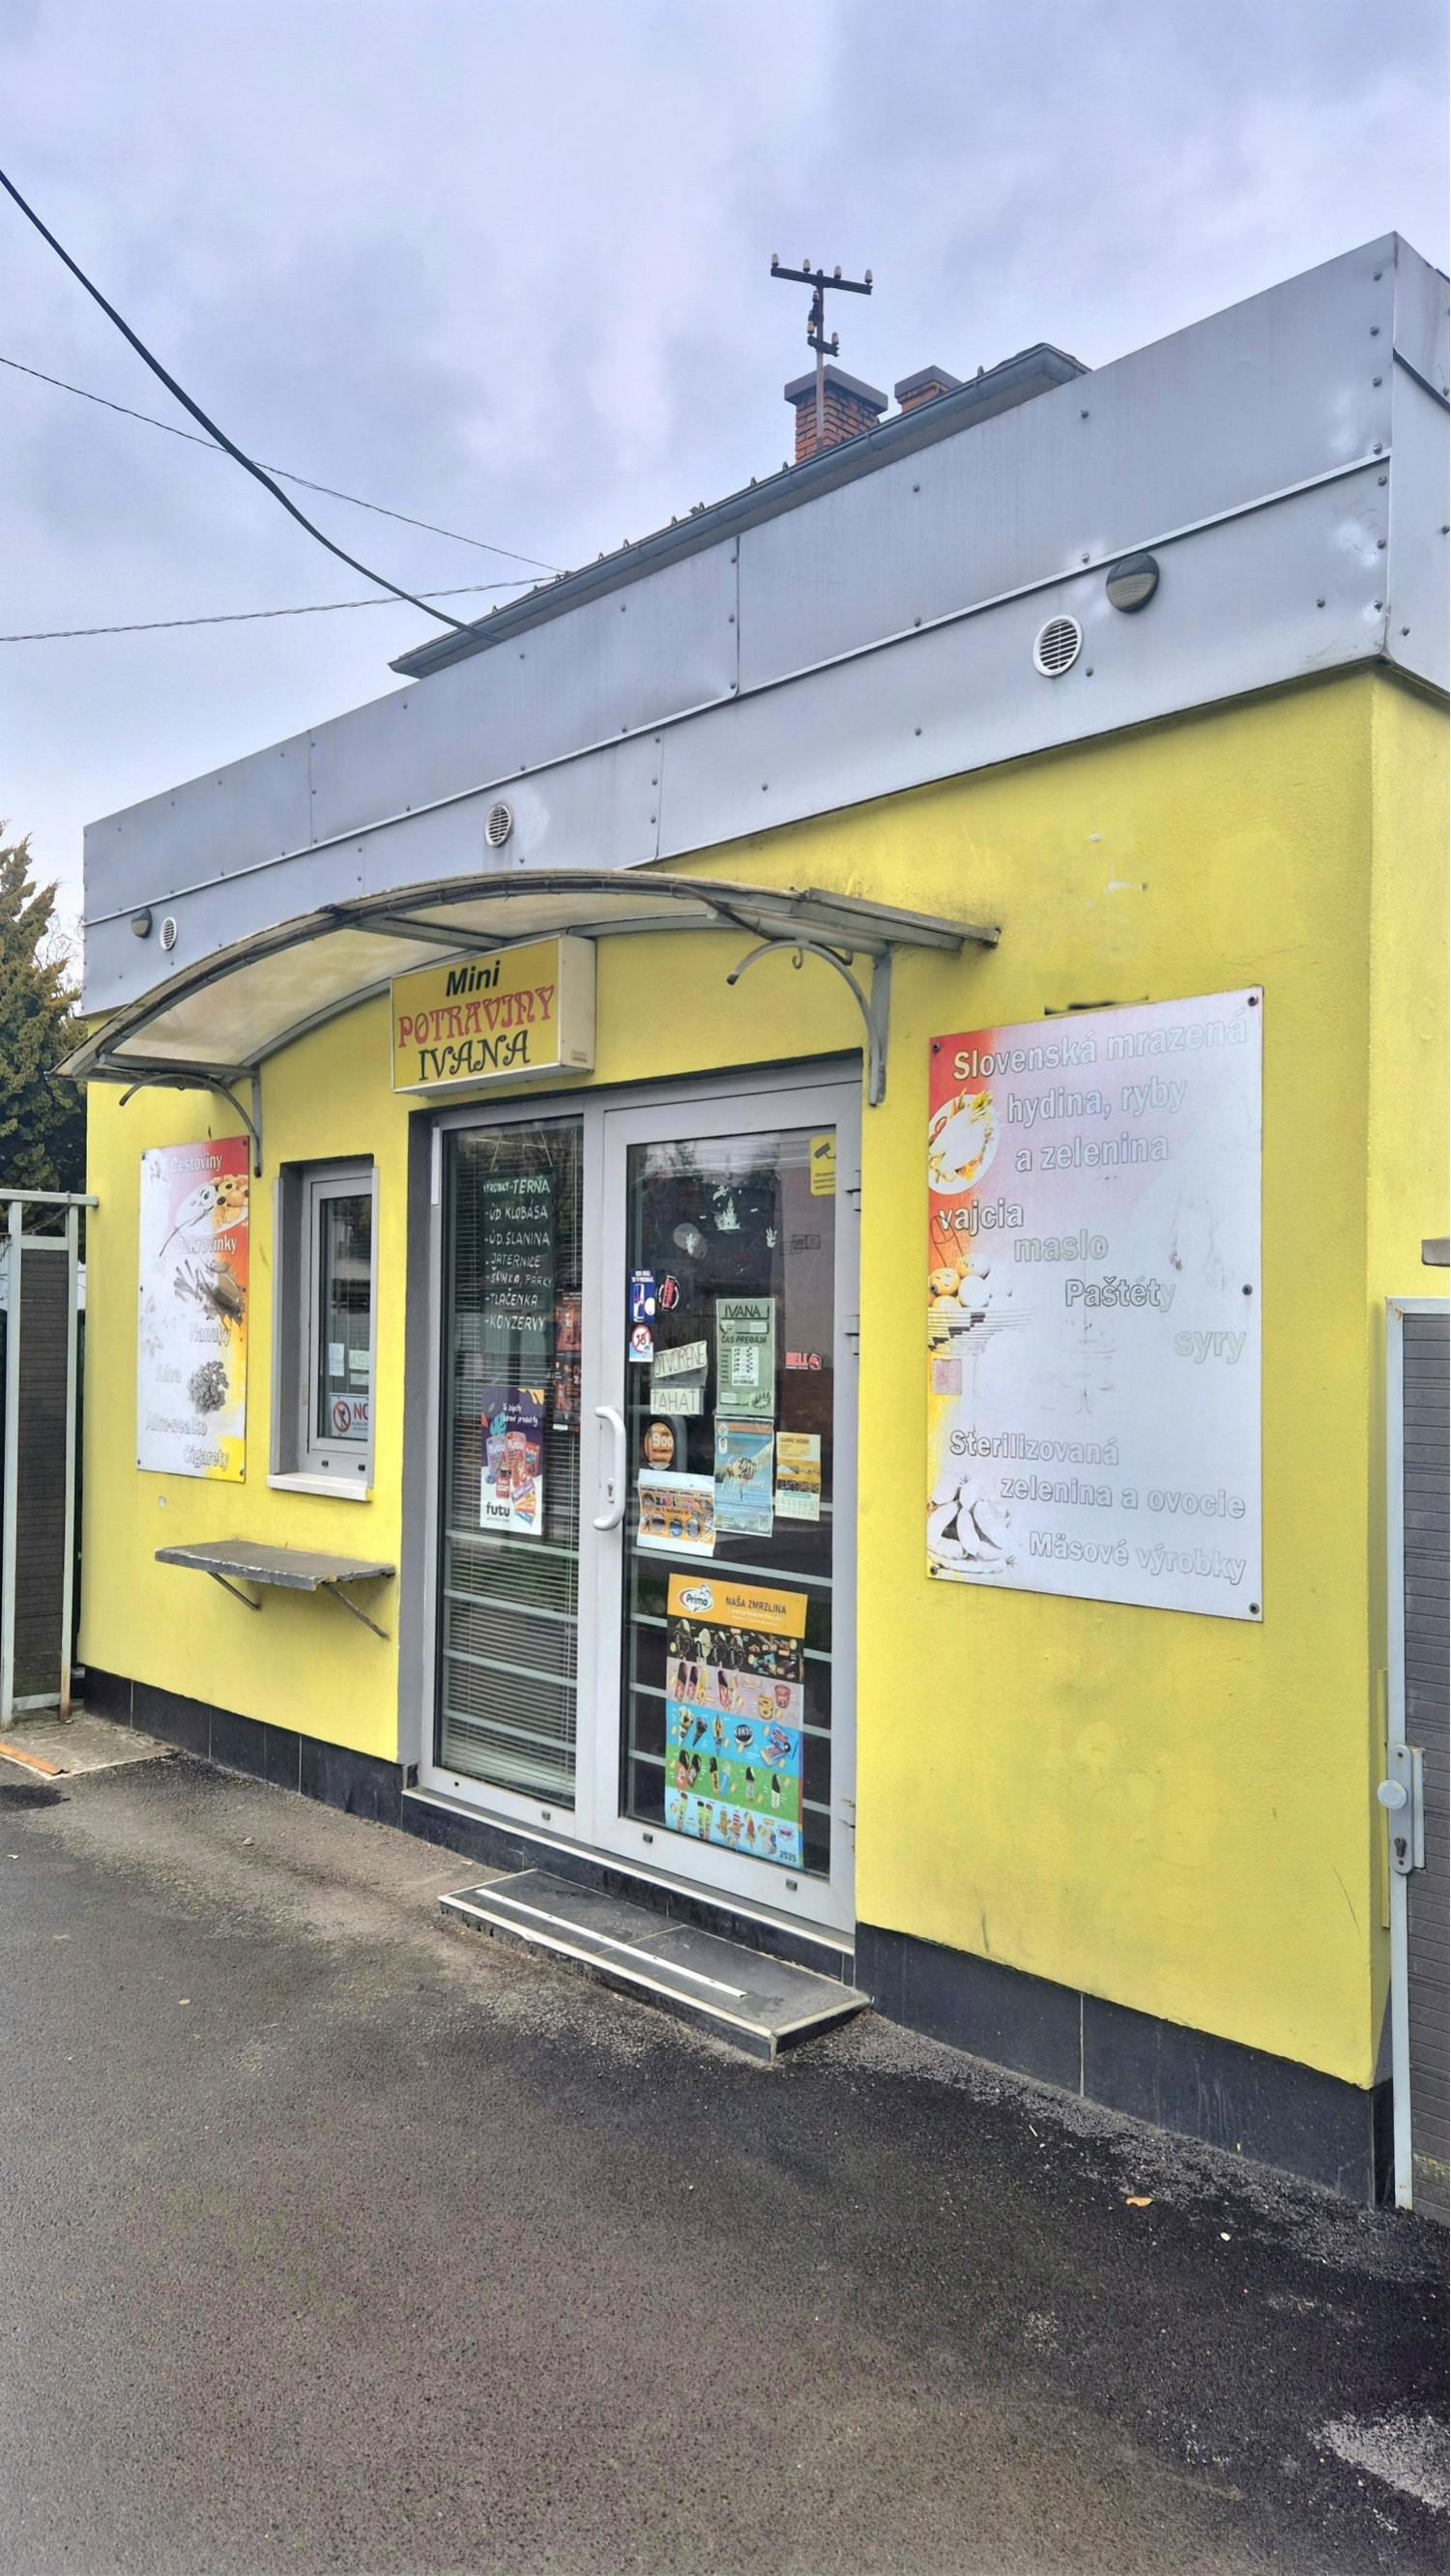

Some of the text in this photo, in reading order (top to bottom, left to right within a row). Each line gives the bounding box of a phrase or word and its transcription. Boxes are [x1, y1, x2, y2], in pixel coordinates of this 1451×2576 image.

[446, 960, 501, 997] Mini
[398, 985, 555, 1048] POTRAVINY
[419, 1029, 531, 1081] IVANA
[952, 1009, 1247, 1081] Slovenská mrazená
[1007, 1076, 1187, 1128] hydina, ryby
[1015, 1132, 1168, 1172] a zelenina
[939, 1199, 1024, 1236] vajcia
[1014, 1229, 1109, 1262] maslo
[725, 1305, 761, 1317] IVANA
[1065, 1275, 1175, 1313] Paštéty
[1175, 1330, 1246, 1365] syry
[949, 1431, 1119, 1466] Sterilizovaná
[486, 1501, 510, 1517] futu
[1001, 1475, 1246, 1519] zelenina a ovocie
[1030, 1531, 1247, 1585] Mäsové výrobky
